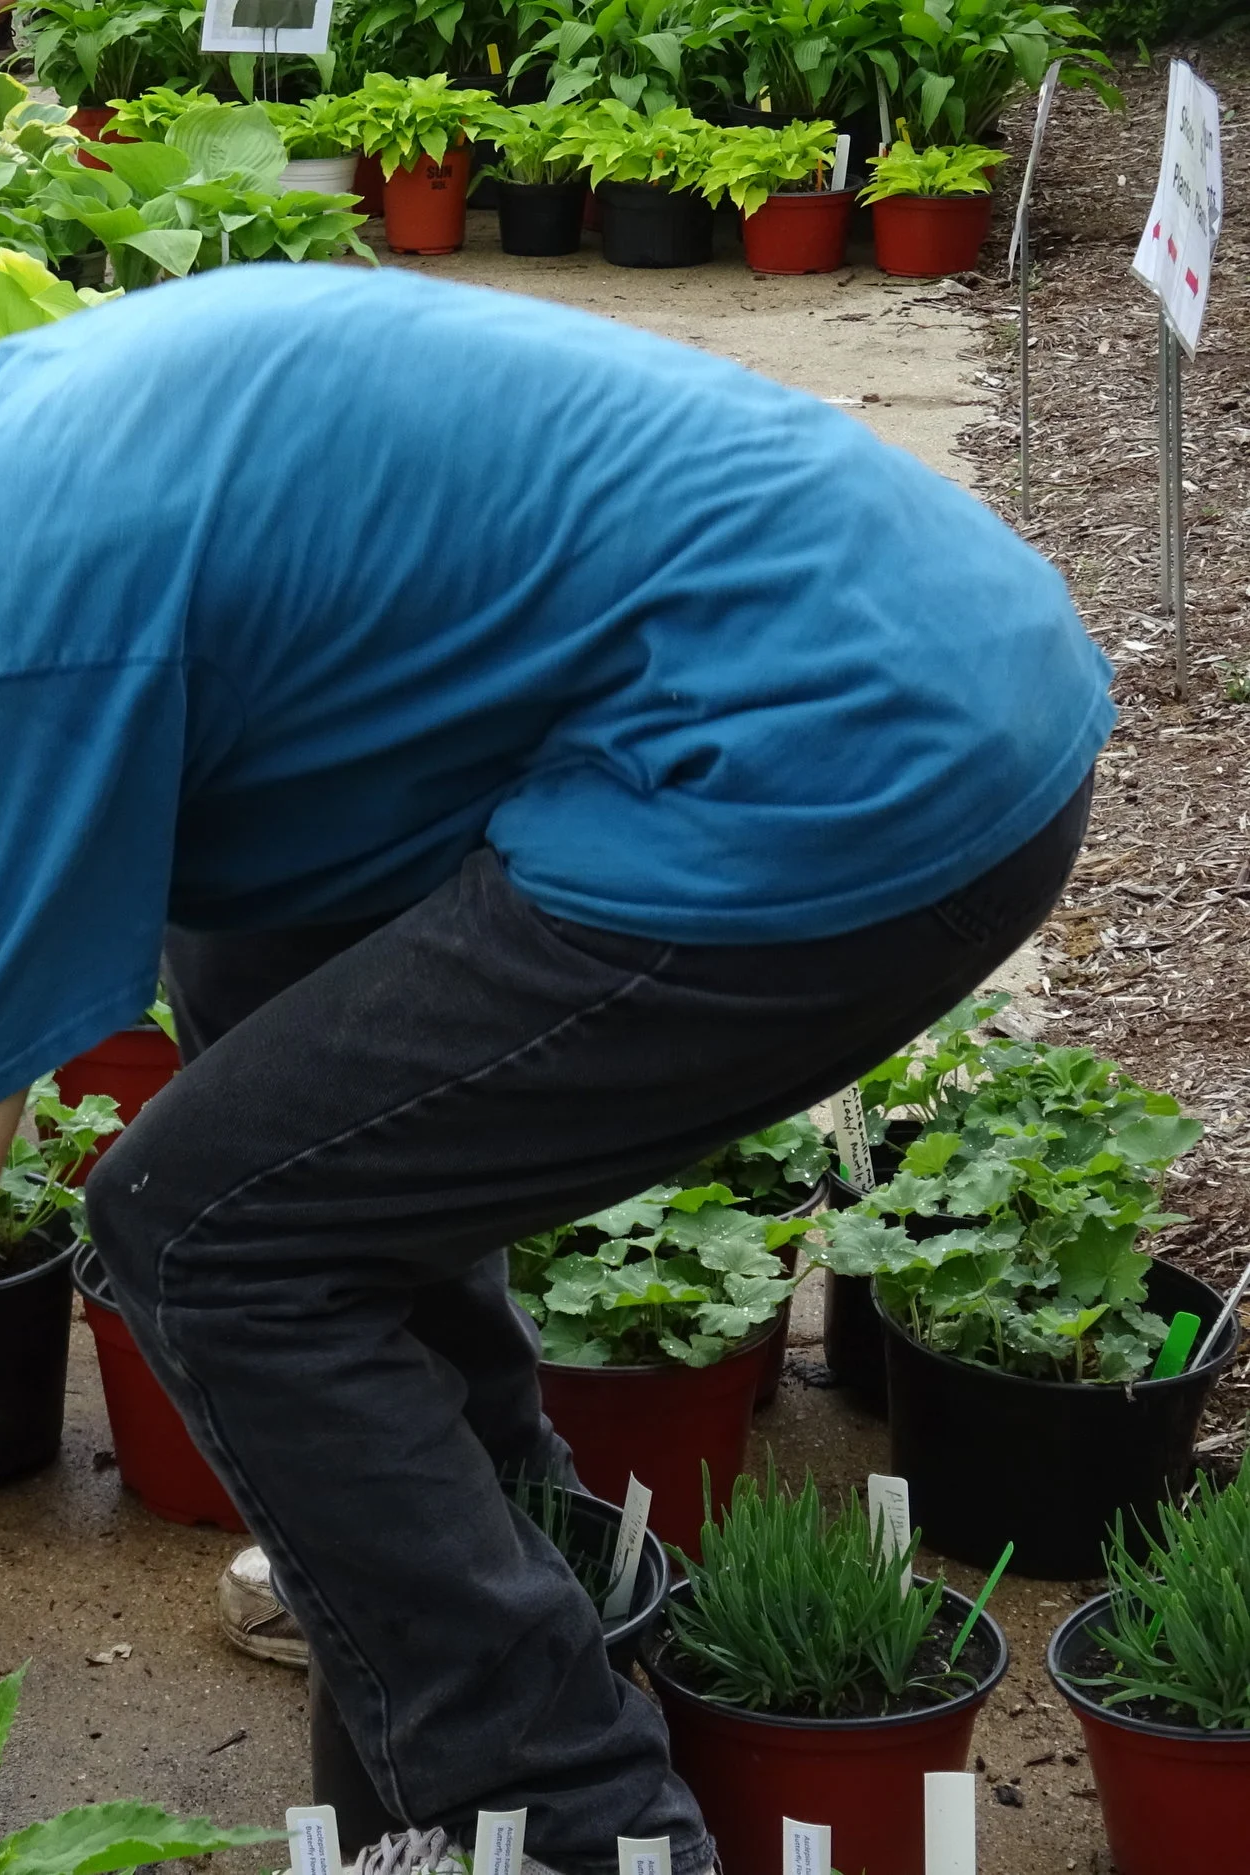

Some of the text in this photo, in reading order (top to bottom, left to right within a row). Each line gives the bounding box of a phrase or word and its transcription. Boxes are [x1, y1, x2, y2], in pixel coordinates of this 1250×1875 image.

[426, 165, 453, 179] SUN
[1173, 162, 1191, 208] Plants
[305, 1825, 315, 1856] Butterfly
